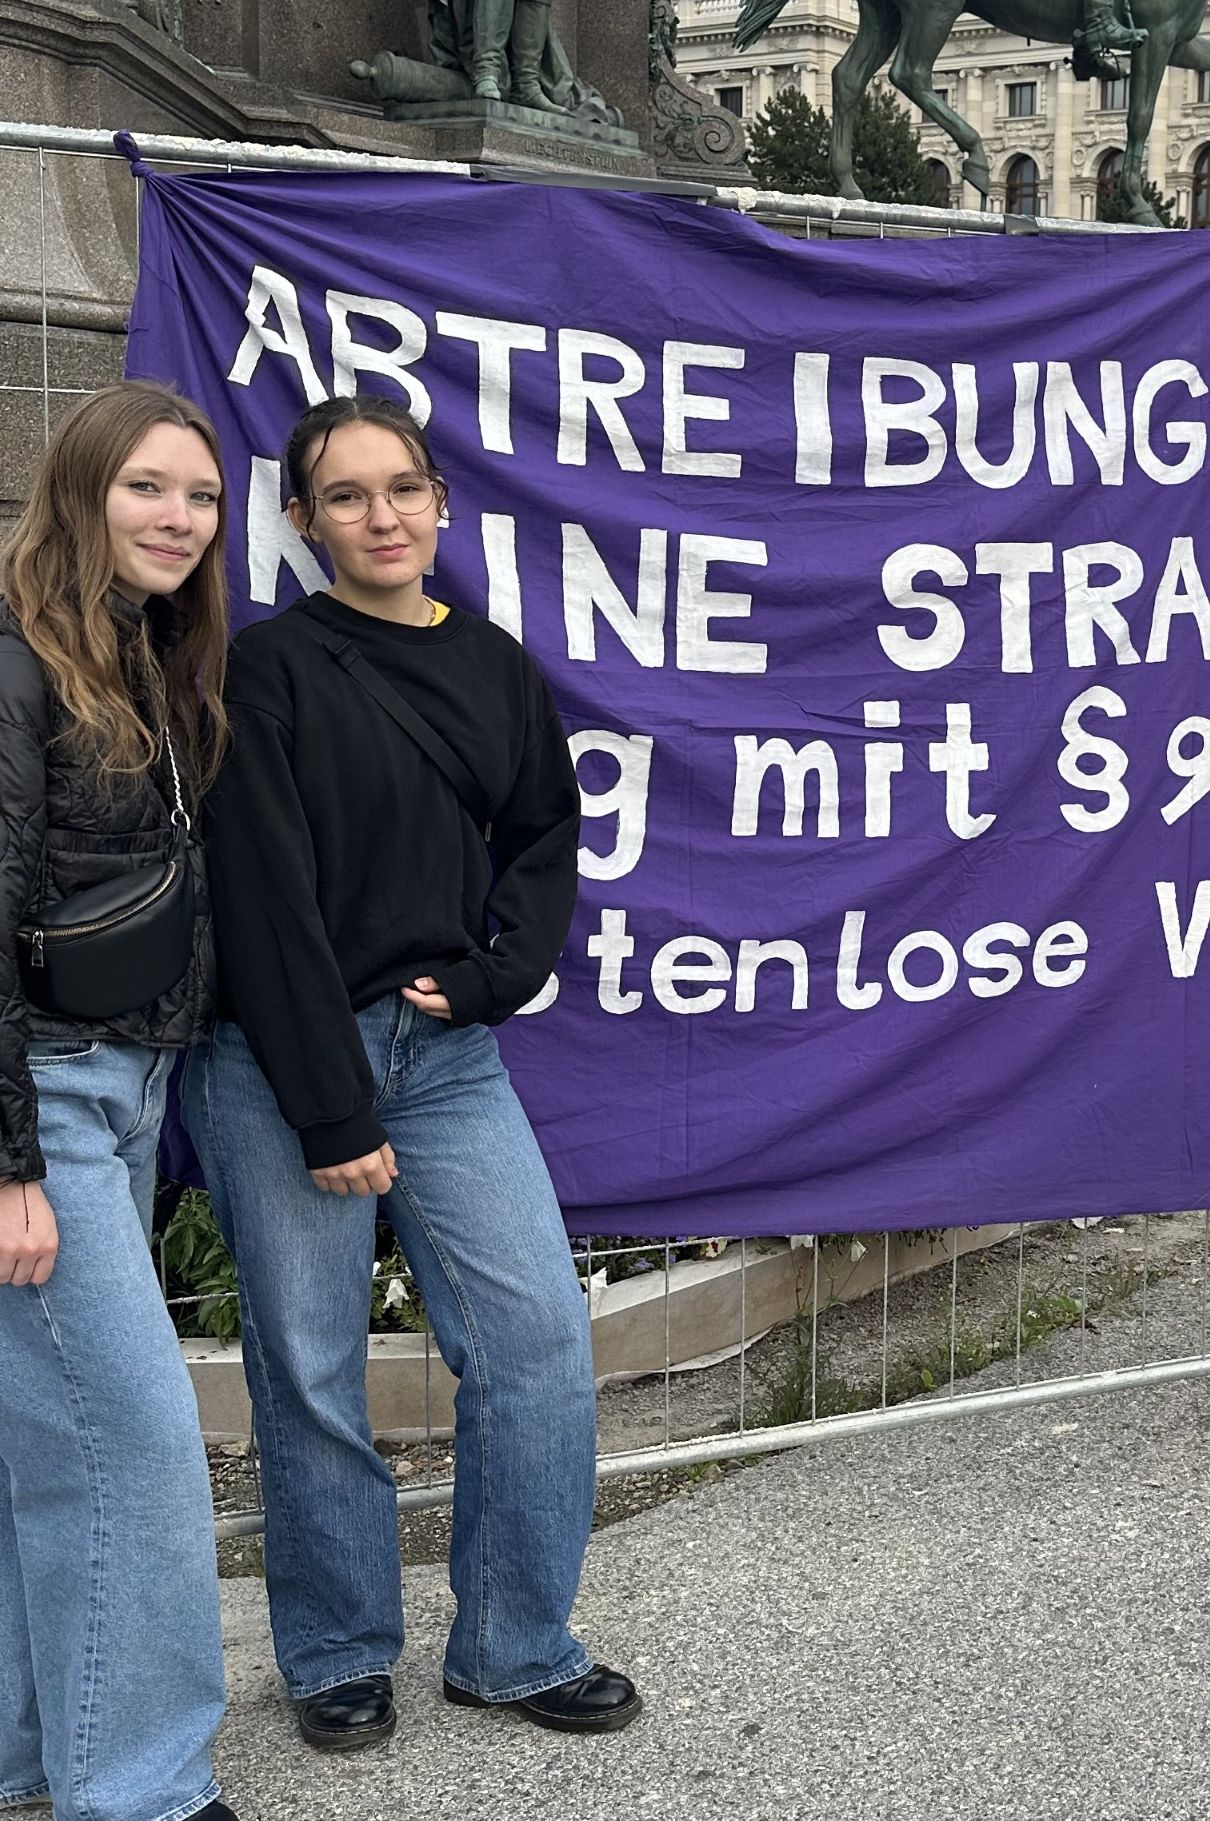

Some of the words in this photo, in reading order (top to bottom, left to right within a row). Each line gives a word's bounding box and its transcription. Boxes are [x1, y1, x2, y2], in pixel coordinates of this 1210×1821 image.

[227, 265, 1209, 489] ABTREIBUNG
[246, 455, 768, 673] KINE
[731, 700, 997, 839] mit
[1056, 686, 1130, 832] §
[490, 908, 1088, 1014] tenlose
